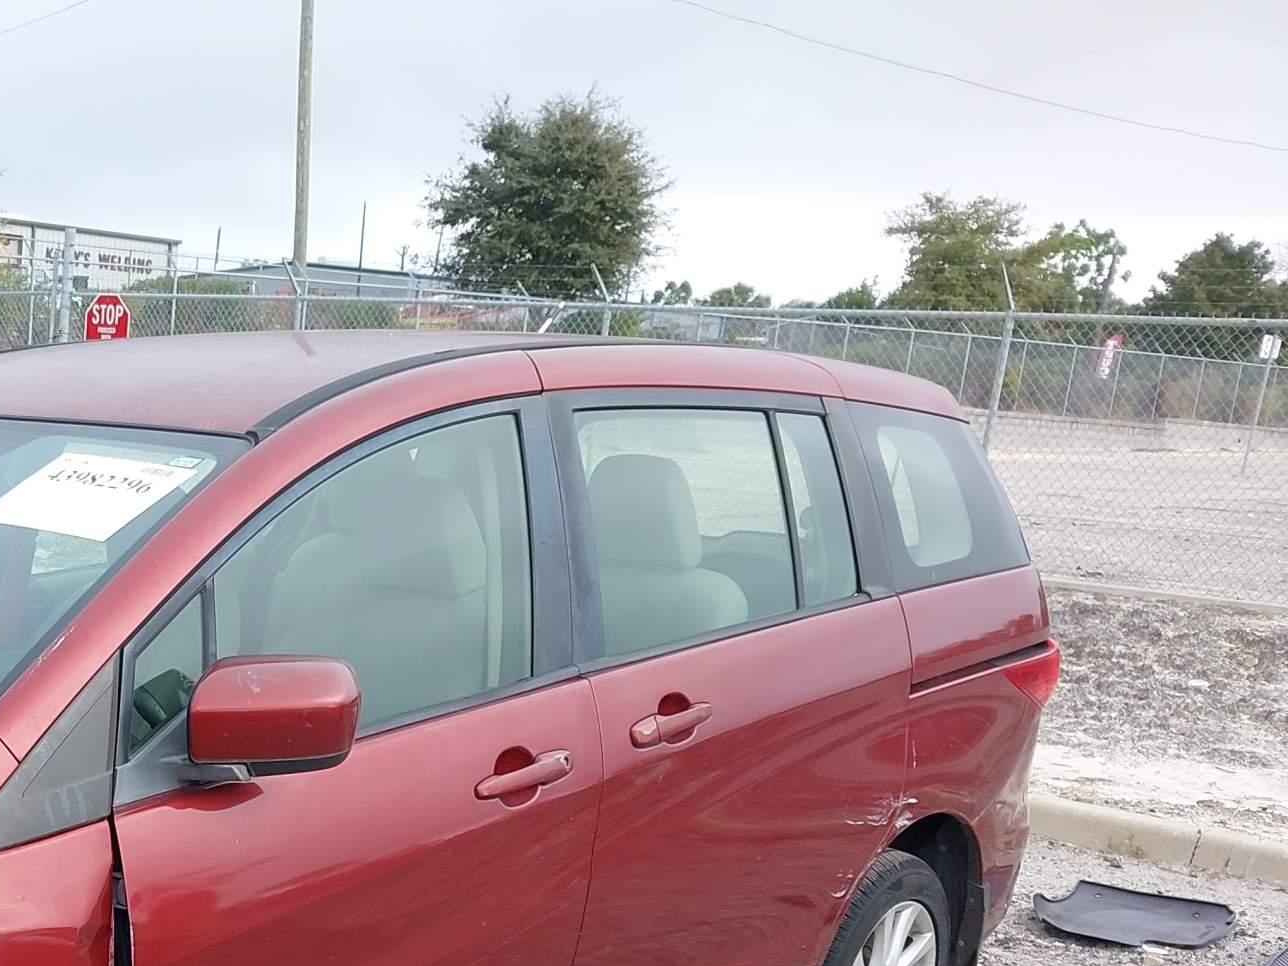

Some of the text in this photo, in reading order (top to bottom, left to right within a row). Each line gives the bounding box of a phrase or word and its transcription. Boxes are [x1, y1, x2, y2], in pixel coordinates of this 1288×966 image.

[45, 247, 152, 274] KEY'S WELDING
[92, 304, 124, 325] STOP
[47, 469, 153, 494] 43982296
